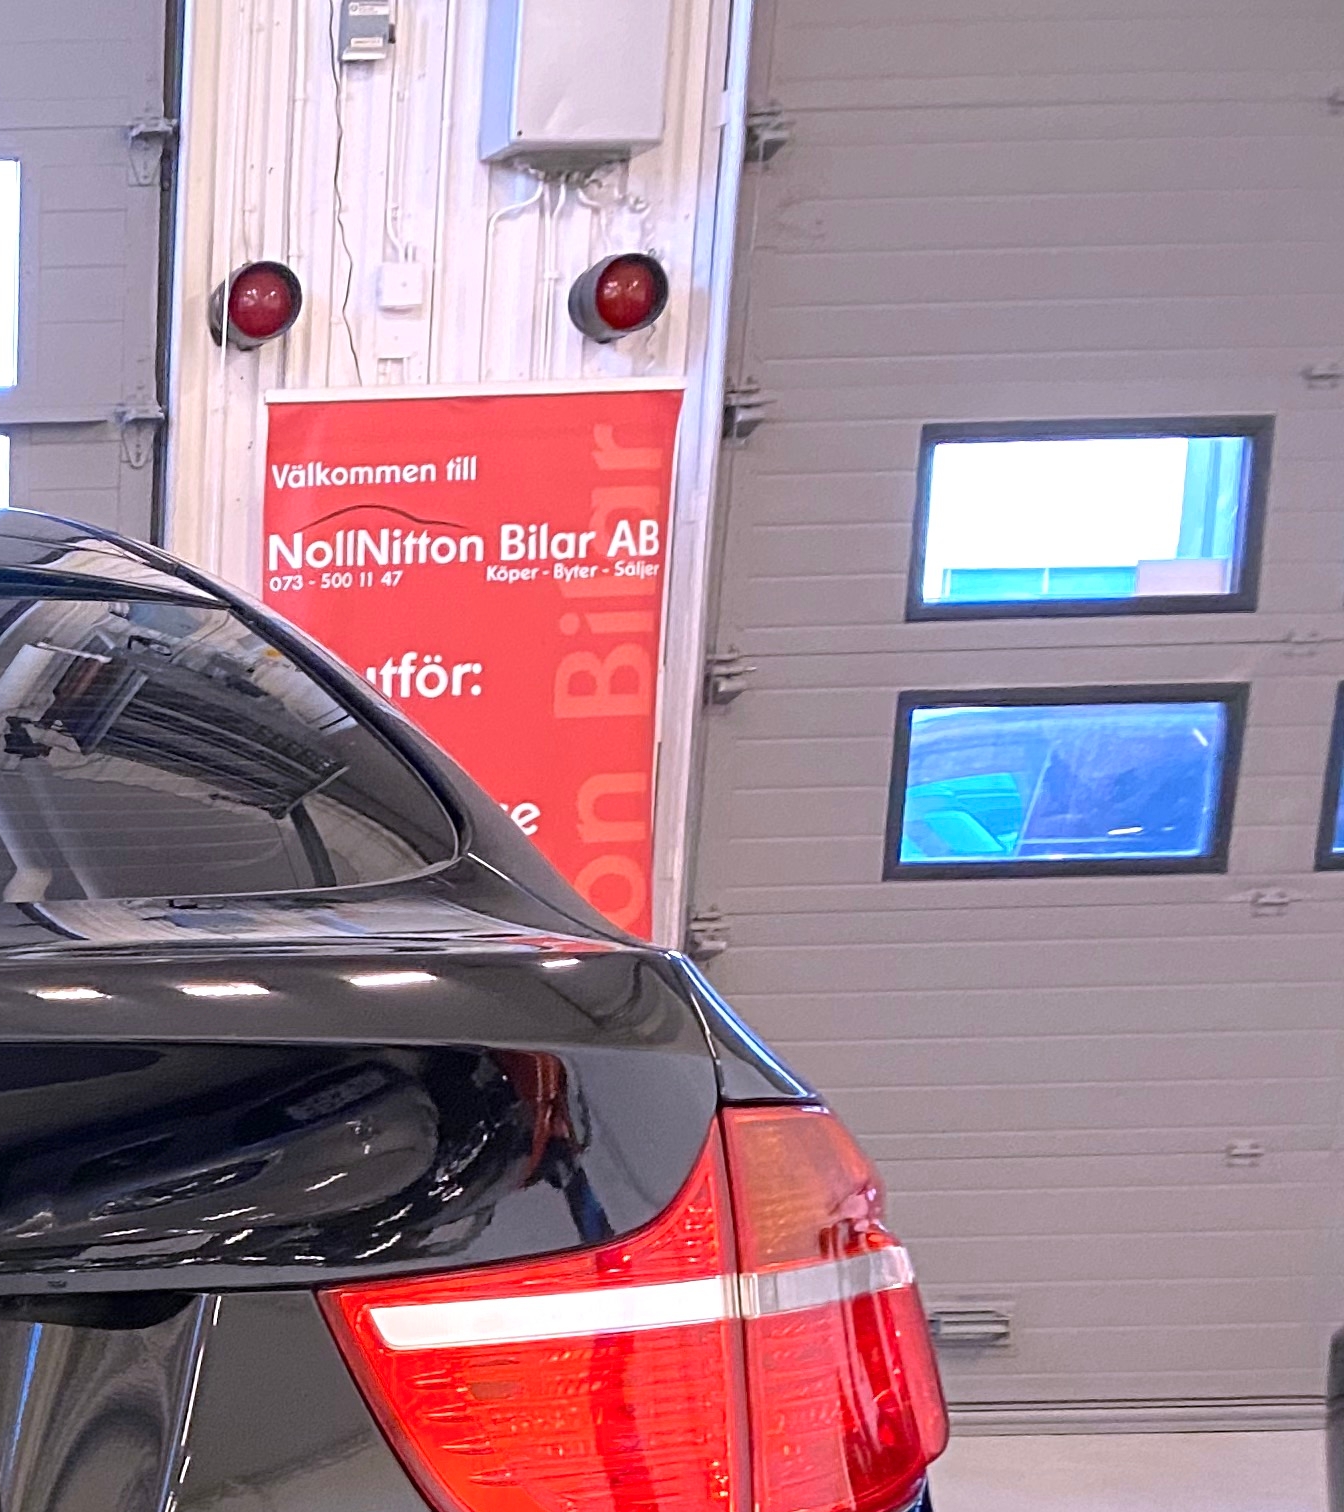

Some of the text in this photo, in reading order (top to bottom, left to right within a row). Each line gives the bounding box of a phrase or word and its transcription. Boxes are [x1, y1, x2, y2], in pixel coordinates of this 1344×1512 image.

[272, 456, 476, 488] Välkommen till
[268, 520, 659, 570] NollNitton Bilar AB
[270, 575, 303, 591] 073
[321, 572, 352, 588] 500
[360, 572, 372, 587] 11
[381, 571, 402, 586] 47
[487, 566, 538, 583] Köper
[554, 563, 597, 582] Byter
[615, 560, 659, 579] Säljer
[553, 424, 662, 718] Bilar
